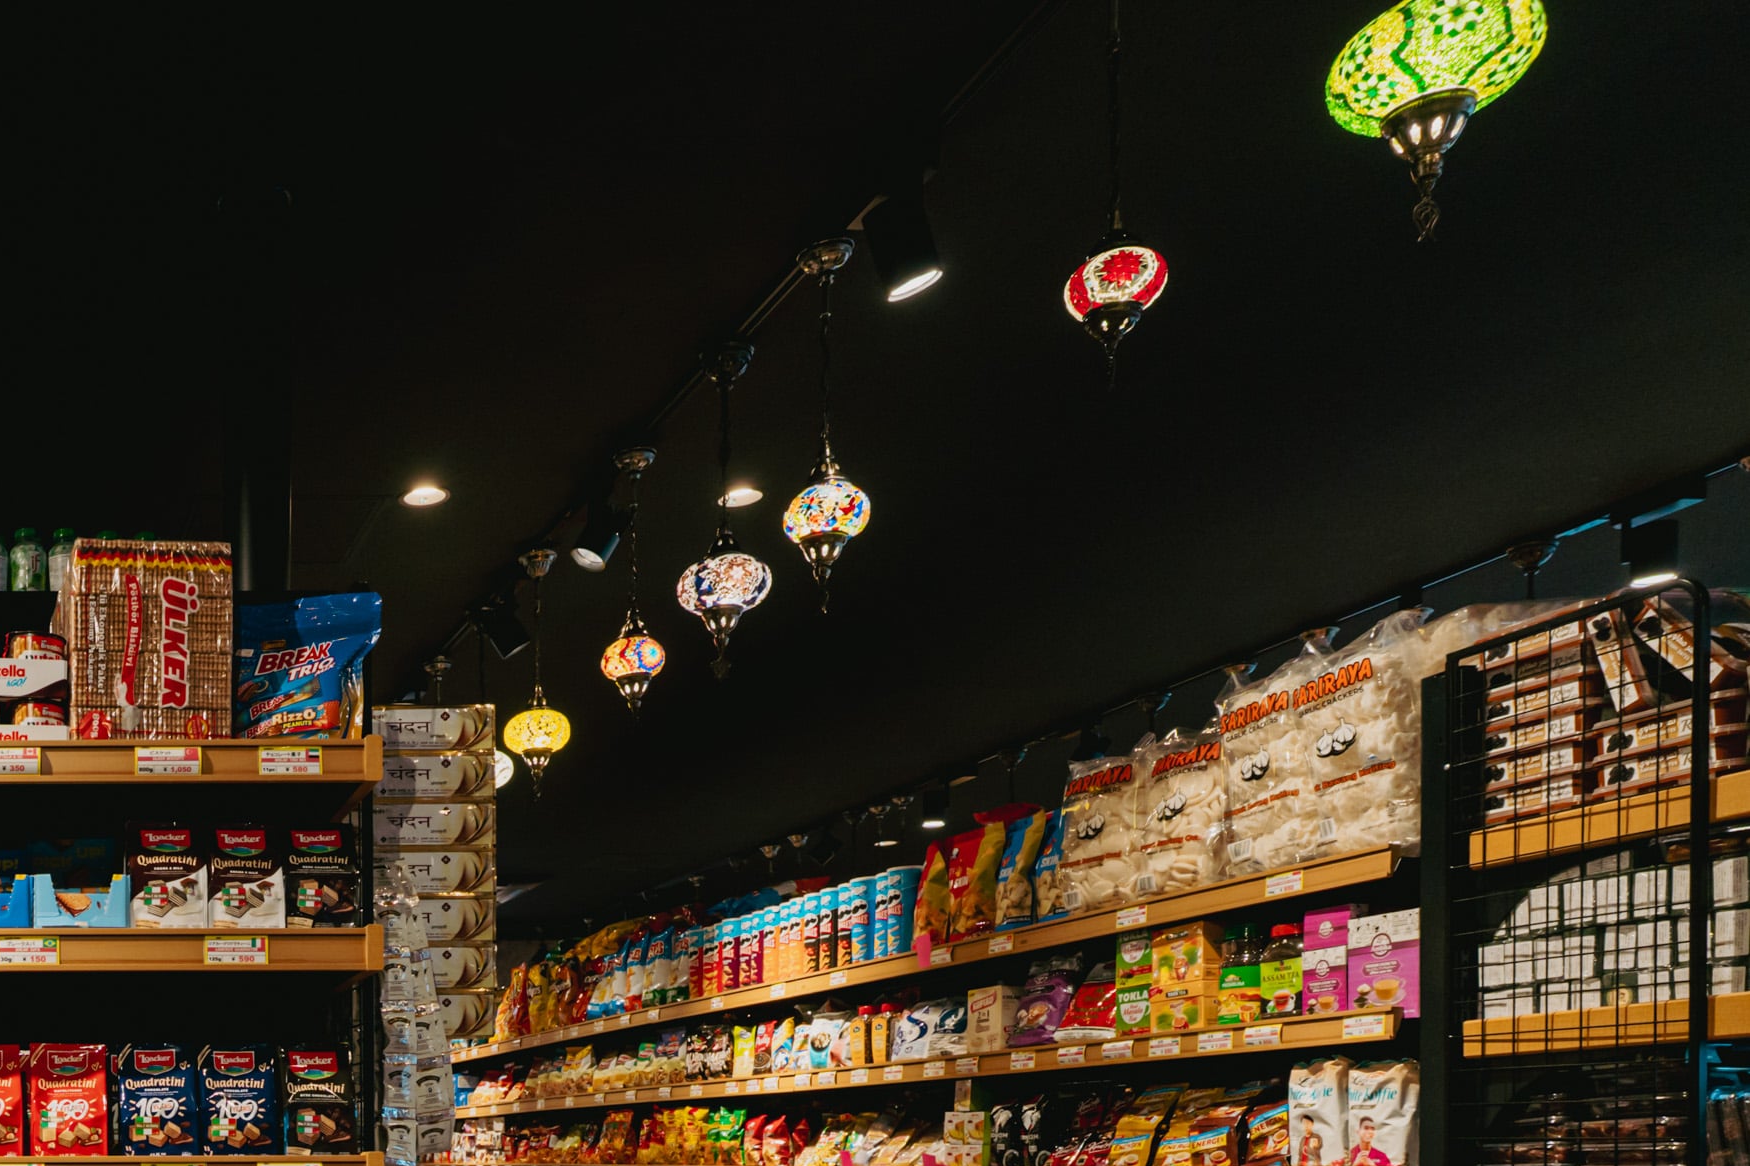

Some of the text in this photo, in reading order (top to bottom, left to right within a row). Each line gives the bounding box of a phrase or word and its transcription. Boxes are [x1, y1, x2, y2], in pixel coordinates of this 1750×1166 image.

[161, 576, 199, 708] ÜLKER
[255, 642, 332, 675] BREAK
[1292, 658, 1374, 709] SARIRAYA
[1219, 690, 1288, 735] SARIRAYA
[170, 766, 192, 774] 1,050
[144, 831, 187, 843] Loacker
[220, 832, 261, 845] Loacker
[295, 832, 338, 844] Loacker
[136, 855, 197, 868] Quadratini
[213, 857, 272, 870] Quadratini
[288, 855, 348, 867] Quadratini
[30, 955, 46, 963] 150
[238, 955, 255, 963] 590
[1118, 988, 1149, 1003] TOKLA
[37, 1077, 97, 1091] Quadratini
[125, 1077, 186, 1090] Quadratini
[205, 1077, 265, 1091] Quadratini
[286, 1082, 346, 1096] Quadratini
